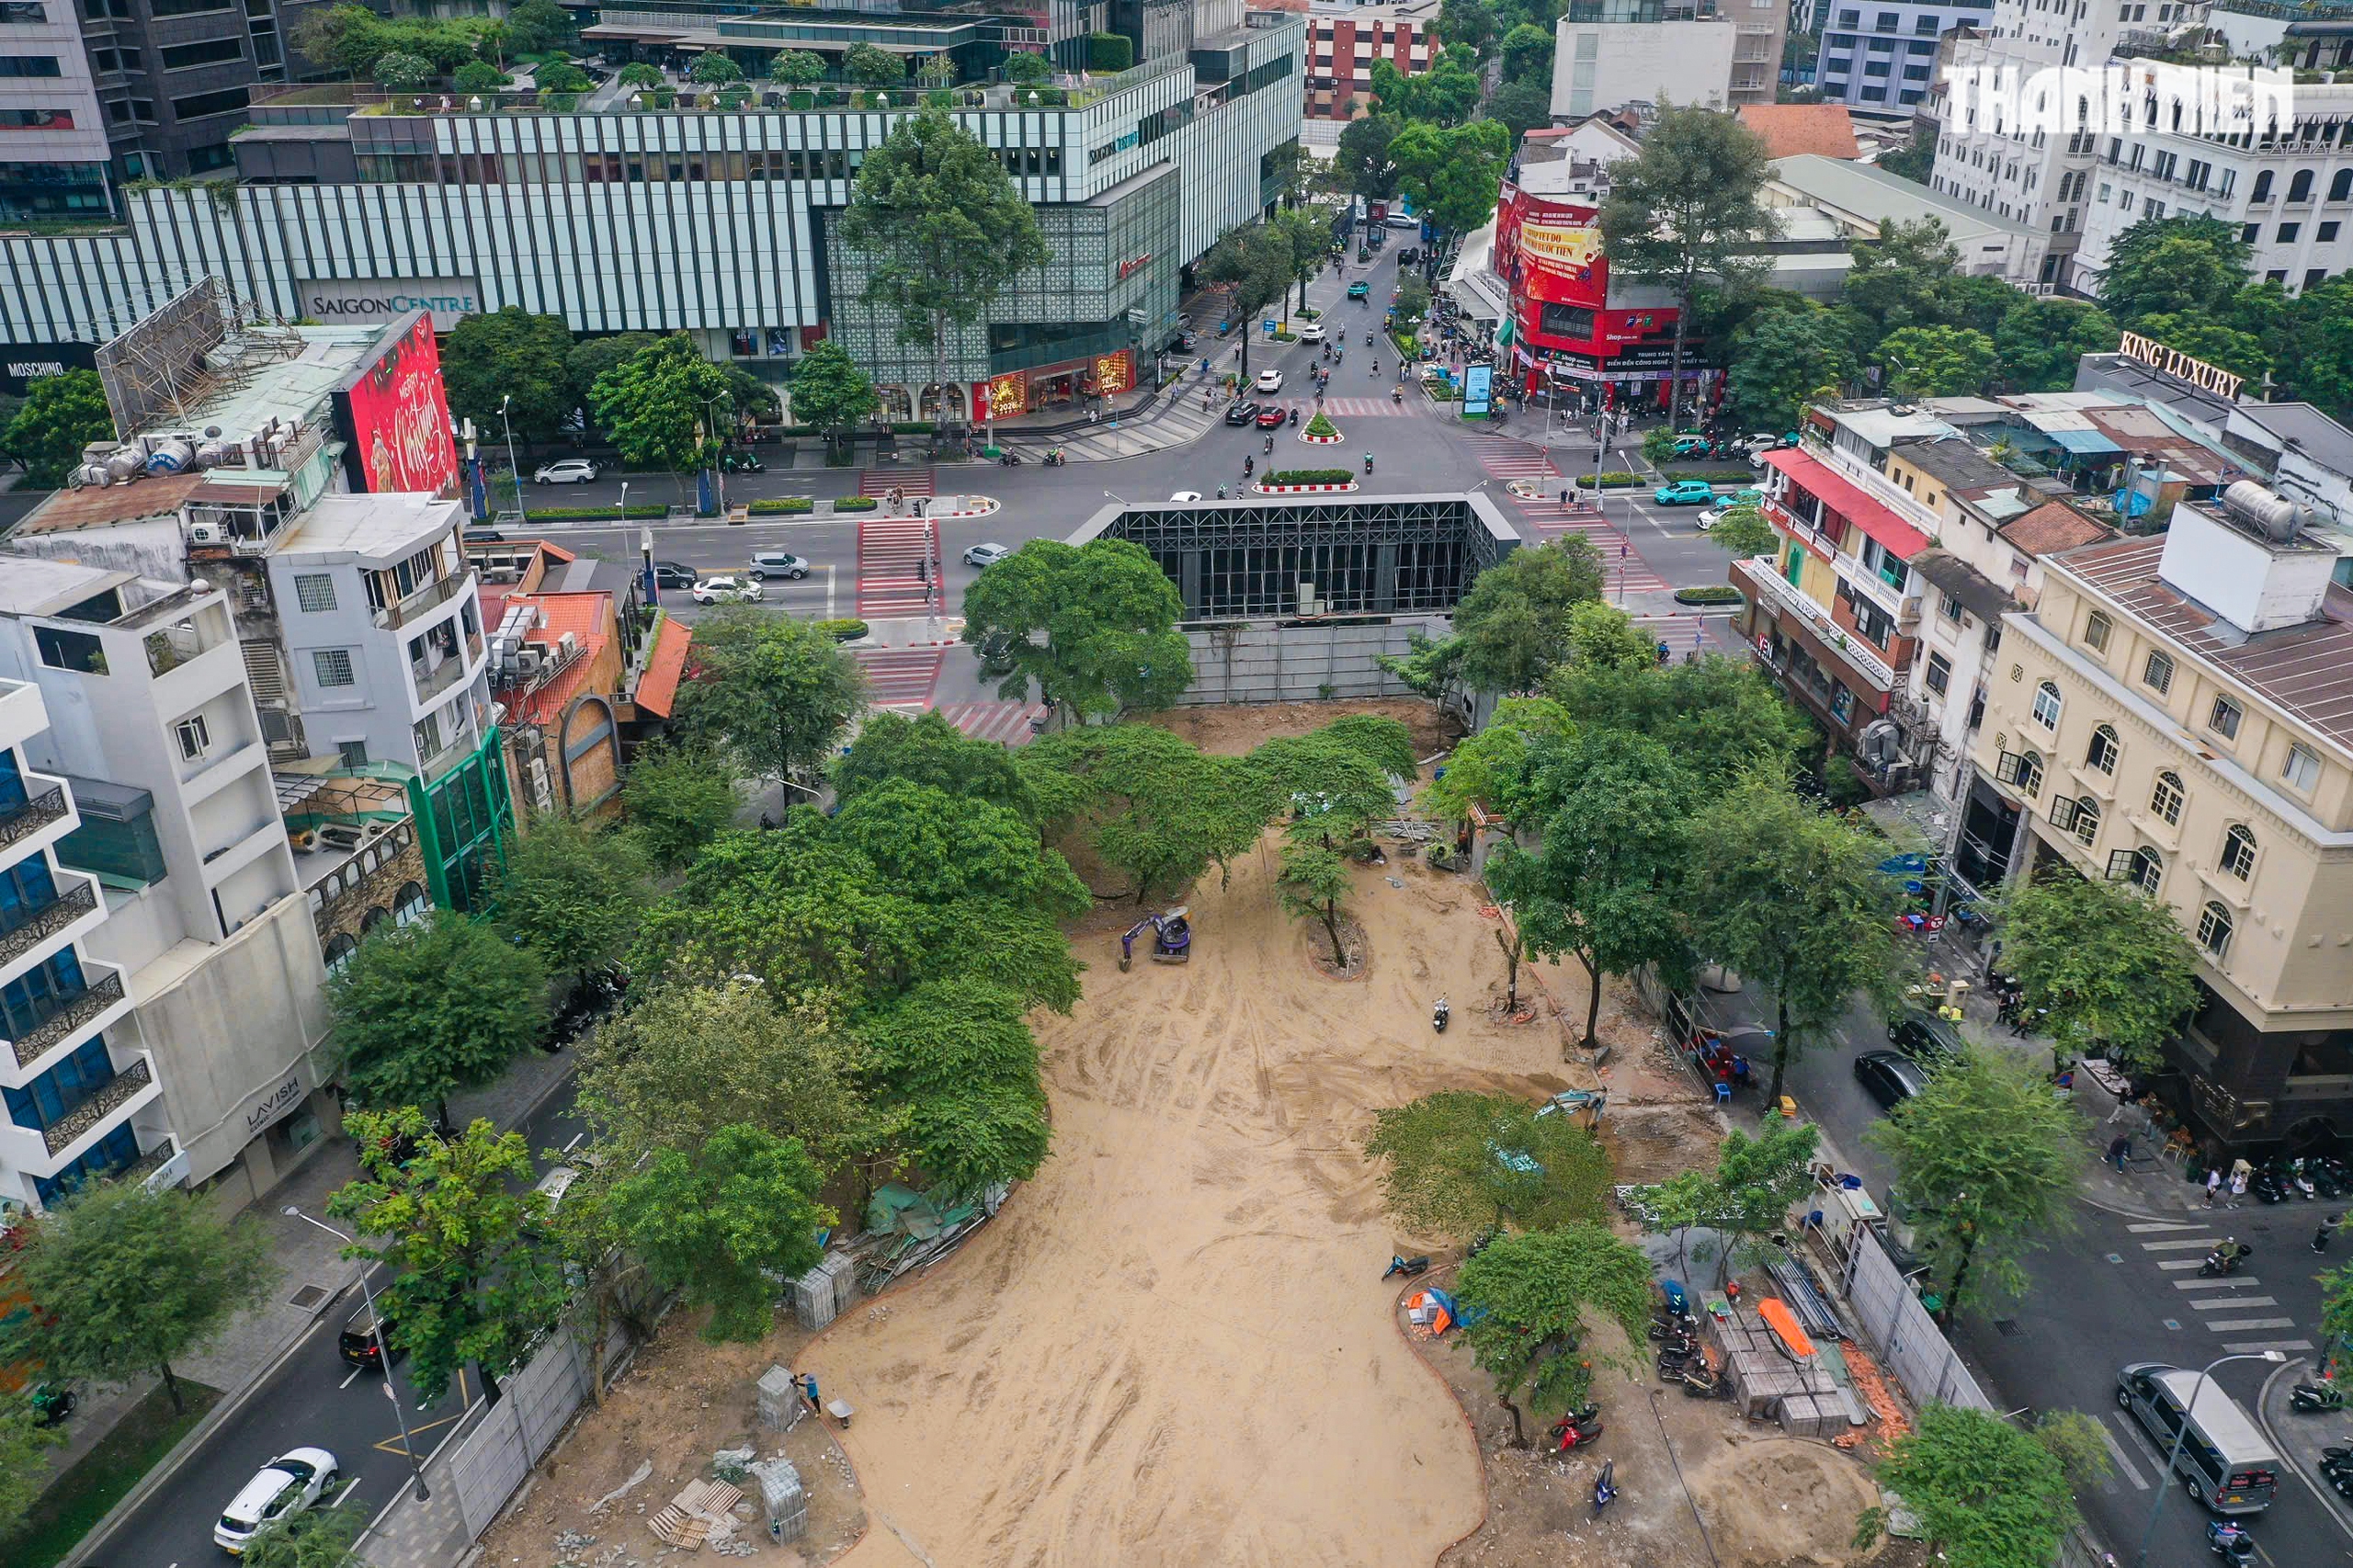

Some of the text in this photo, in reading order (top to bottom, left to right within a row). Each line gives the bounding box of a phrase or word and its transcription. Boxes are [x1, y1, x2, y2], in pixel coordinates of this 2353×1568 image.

[1626, 315, 1653, 327] FPT
[7, 361, 63, 377] MOSCHINO
[2119, 330, 2246, 401] KING LUXURY
[399, 369, 420, 400] MERRY
[247, 1076, 299, 1126] LAVISH
